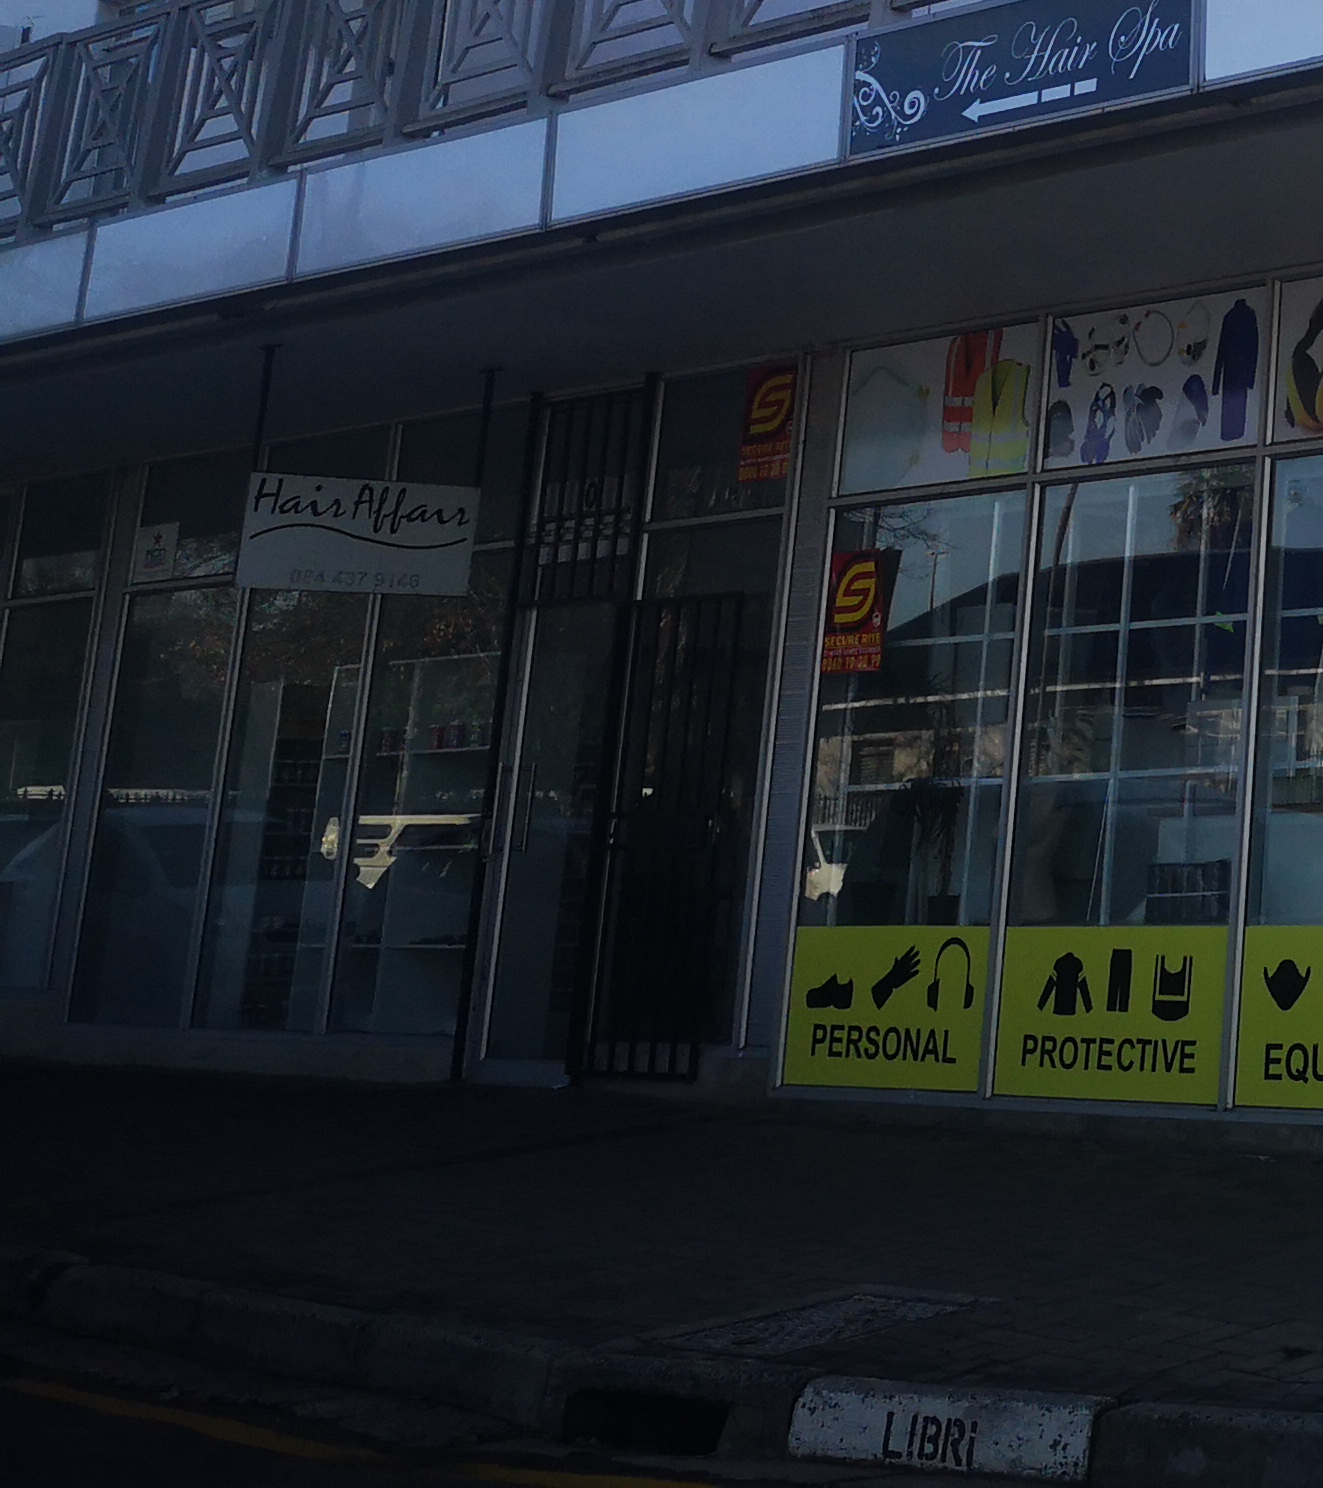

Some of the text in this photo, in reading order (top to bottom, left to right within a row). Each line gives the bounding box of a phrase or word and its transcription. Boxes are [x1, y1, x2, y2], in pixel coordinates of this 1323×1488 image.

[933, 34, 999, 101] The
[1004, 17, 1098, 86] Hair
[254, 478, 470, 534] Hair Affair
[810, 1023, 957, 1065] PERSONAL
[1020, 1034, 1197, 1074] PROTECTIVE
[882, 1411, 979, 1467] LIBRI
